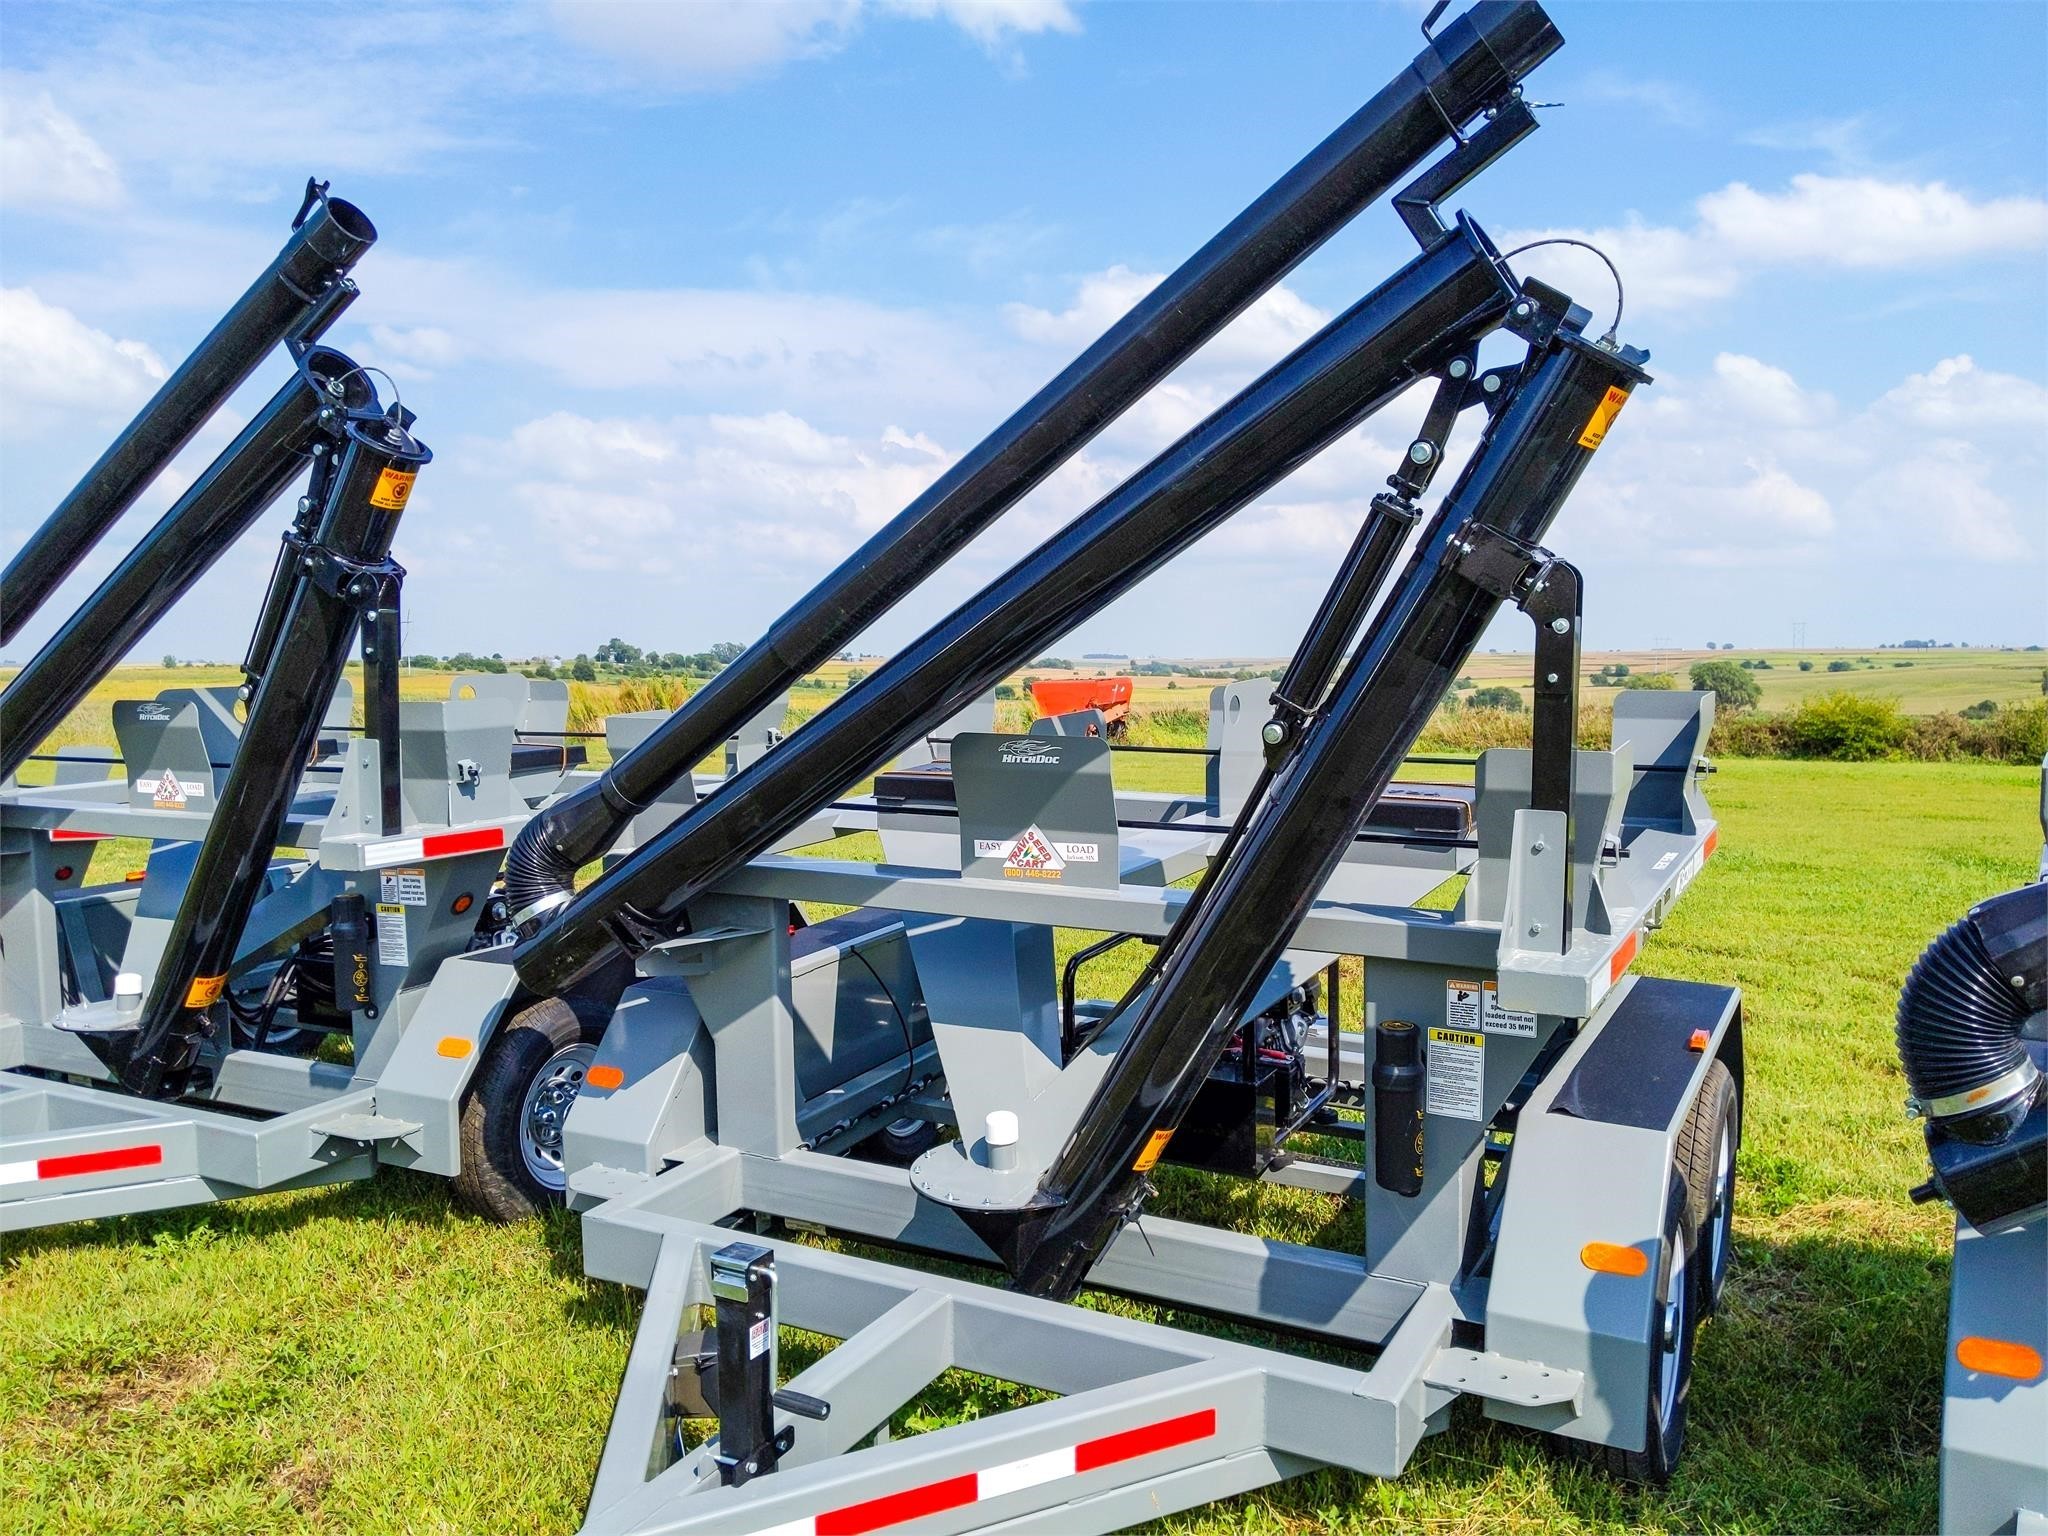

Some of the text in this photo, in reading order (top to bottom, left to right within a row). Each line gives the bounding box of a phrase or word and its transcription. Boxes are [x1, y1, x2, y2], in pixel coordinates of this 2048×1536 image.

[979, 842, 1002, 851] EASY
[1066, 844, 1094, 854] LOAD
[1017, 859, 1047, 869] CART
[1485, 1012, 1506, 1020] loaded
[1485, 1021, 1507, 1029] exceed
[1518, 1024, 1534, 1032] MPH
[1437, 1031, 1476, 1045] CAUTION
